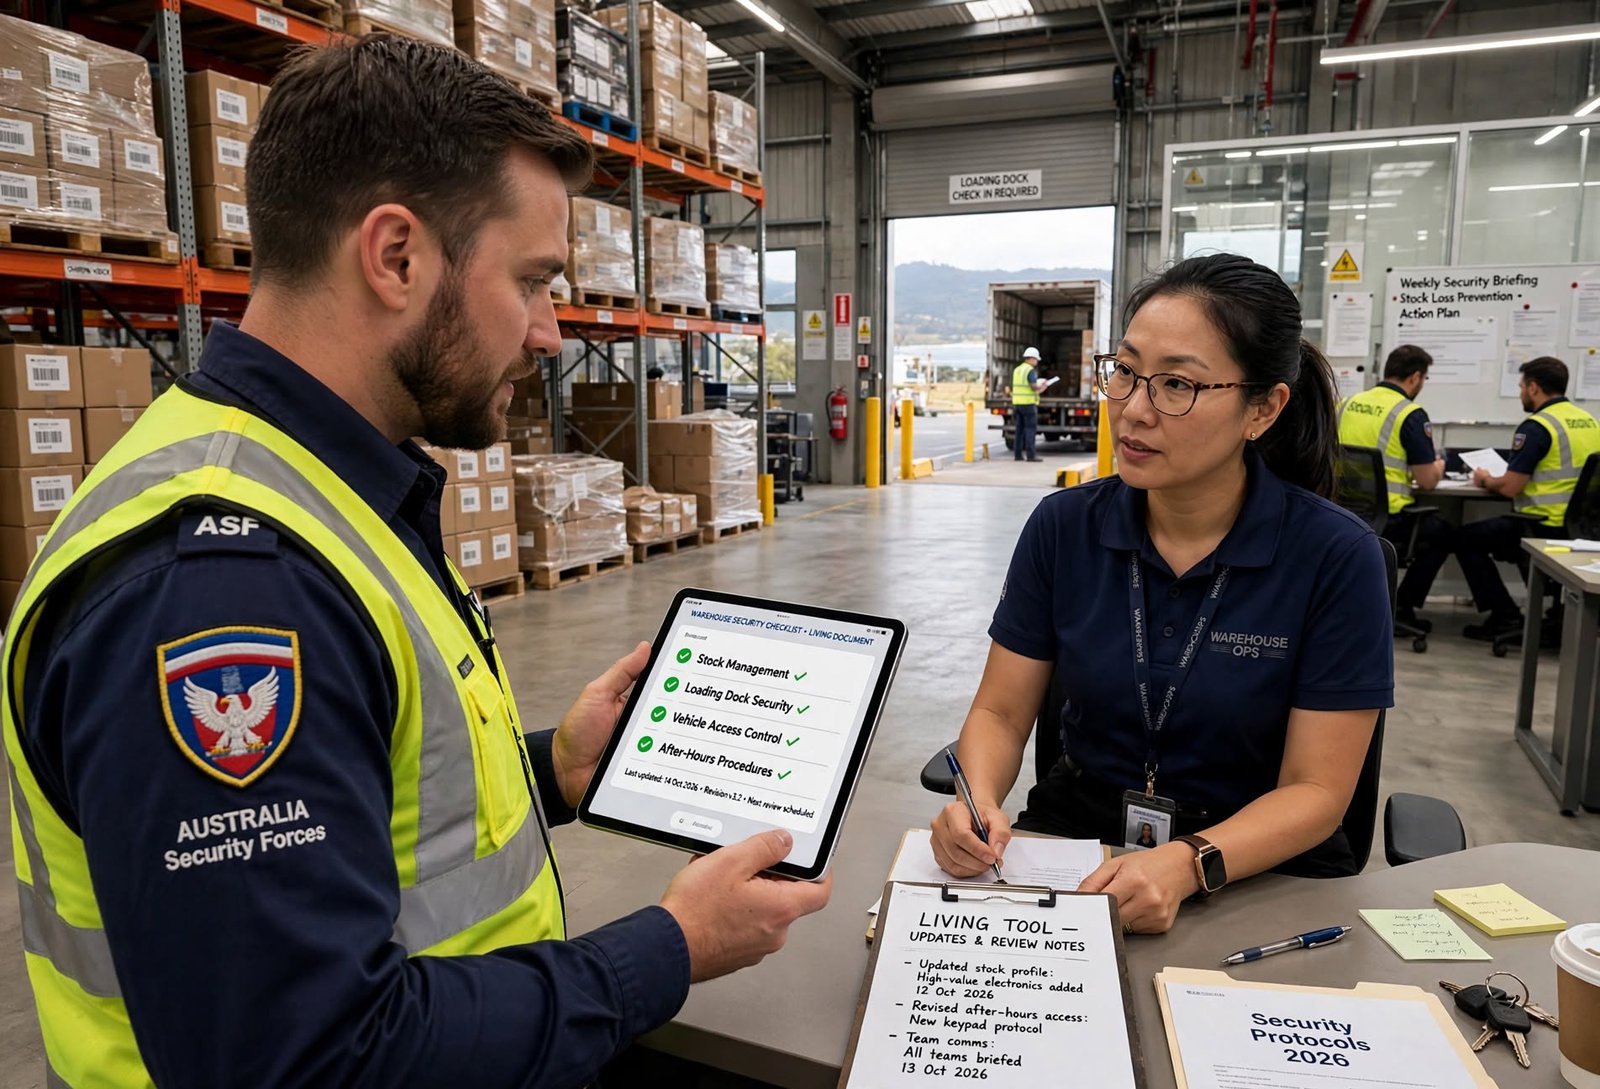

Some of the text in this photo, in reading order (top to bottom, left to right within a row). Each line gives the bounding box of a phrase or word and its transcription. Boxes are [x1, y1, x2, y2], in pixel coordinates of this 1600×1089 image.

[961, 173, 1029, 187] LOADING DOCK
[953, 186, 1038, 200] CHECK IN REQUIRED
[1401, 274, 1538, 289] Weekly Security Briefing
[1400, 291, 1513, 304] Stock Loss Prevention
[1400, 307, 1460, 319] Action Plan
[194, 515, 259, 536] ASF
[691, 609, 732, 623] WAREHOUSE
[732, 616, 765, 628] SECURITY
[766, 621, 803, 634] CHECKLIST
[809, 628, 832, 639] LIVING
[833, 632, 874, 646] DOCUMENT
[1211, 632, 1288, 649] WAREHOUSE
[1233, 645, 1260, 658] OPS
[697, 653, 789, 680] Stock Management
[685, 682, 793, 714] Loading Dock Security
[673, 712, 782, 744] Vehicle Access Control
[658, 743, 773, 778] After-Hours Procedures
[625, 768, 638, 778] Last
[638, 771, 662, 784] updated:
[672, 778, 683, 788] Oct
[683, 781, 698, 791] 2026
[704, 786, 729, 799] Revision
[747, 797, 762, 807] Next
[763, 801, 782, 811] review
[783, 804, 814, 818] scheduled
[177, 799, 310, 843] AUSTRALIA
[164, 824, 326, 871] Security Forces
[919, 912, 1053, 935] LIVING TOOL
[910, 931, 1085, 952] UPDATES & REVIEW NOTES
[919, 959, 1054, 979] Updated stock profile:
[916, 984, 994, 1000] 12 Oct 2026
[917, 971, 1083, 993] High-value electronics added
[912, 1000, 1088, 1023] Revised after-hours access:
[910, 1014, 1042, 1035] New keypad protocol
[1251, 1012, 1352, 1036] Security
[907, 1032, 994, 1048] Team comms:
[1250, 1028, 1370, 1051] Protocols
[904, 1046, 1022, 1067] All teams briefed
[1283, 1048, 1350, 1067] 2026
[902, 1062, 988, 1079] 13 Oct 2026
